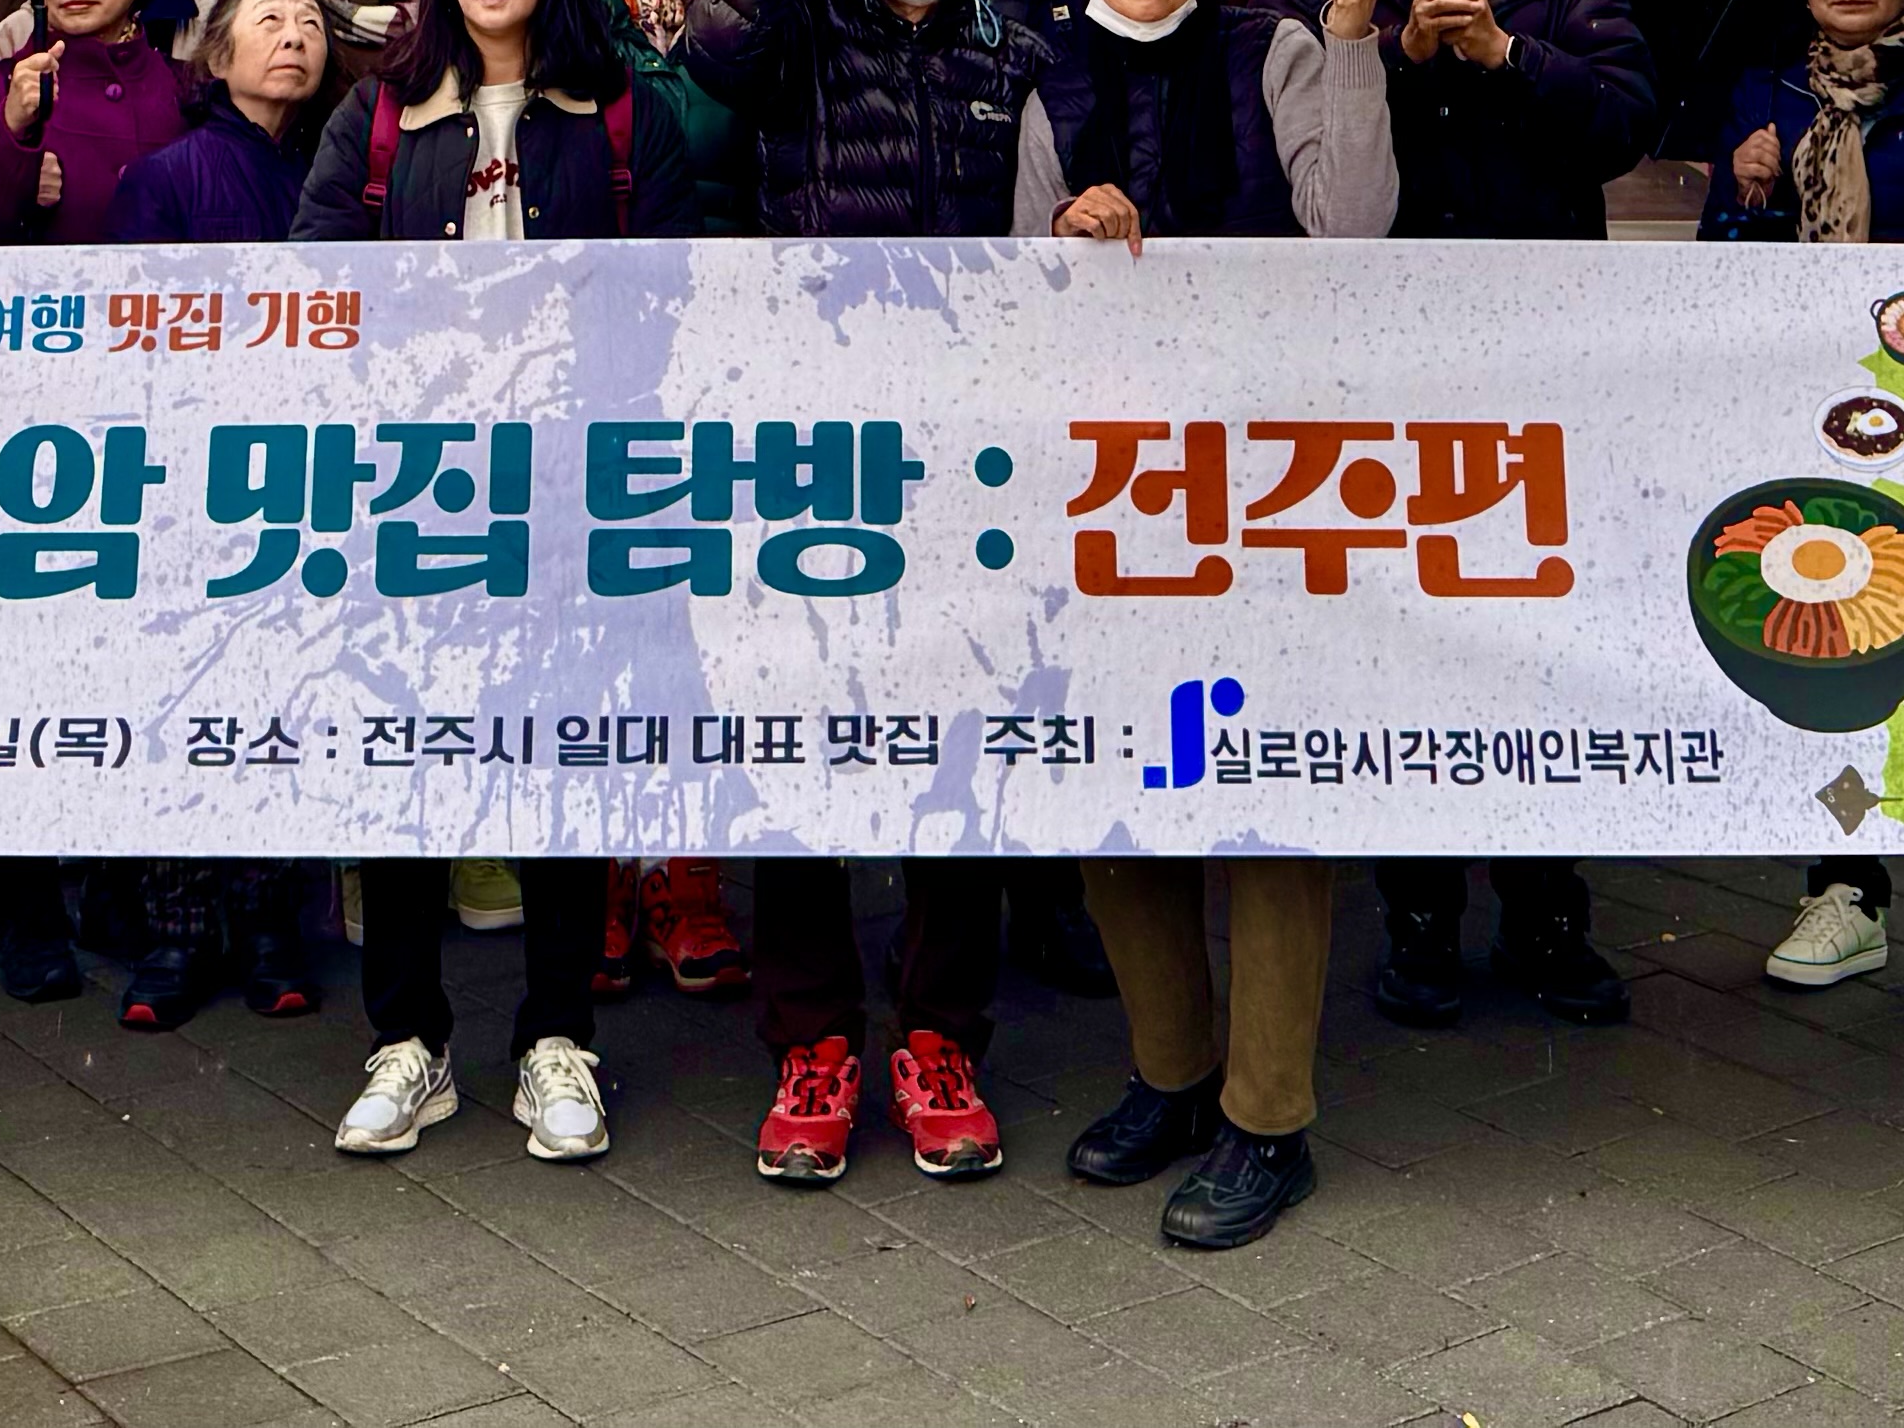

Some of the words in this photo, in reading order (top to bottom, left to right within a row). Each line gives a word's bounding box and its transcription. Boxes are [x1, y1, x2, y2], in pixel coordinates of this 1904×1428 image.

[108, 292, 223, 353] 맛집
[246, 290, 361, 350] 기행
[205, 421, 533, 599] 맛집
[585, 420, 926, 598] 탐방
[1066, 420, 1575, 598] 전주편
[186, 716, 300, 767] 장소
[362, 715, 534, 767] 전주시
[556, 715, 669, 767] 일대
[692, 715, 806, 764] 대표
[827, 714, 939, 766] 맛집
[983, 714, 1095, 766] 주최
[1210, 727, 1724, 787] 실로암시각장애인복지관
